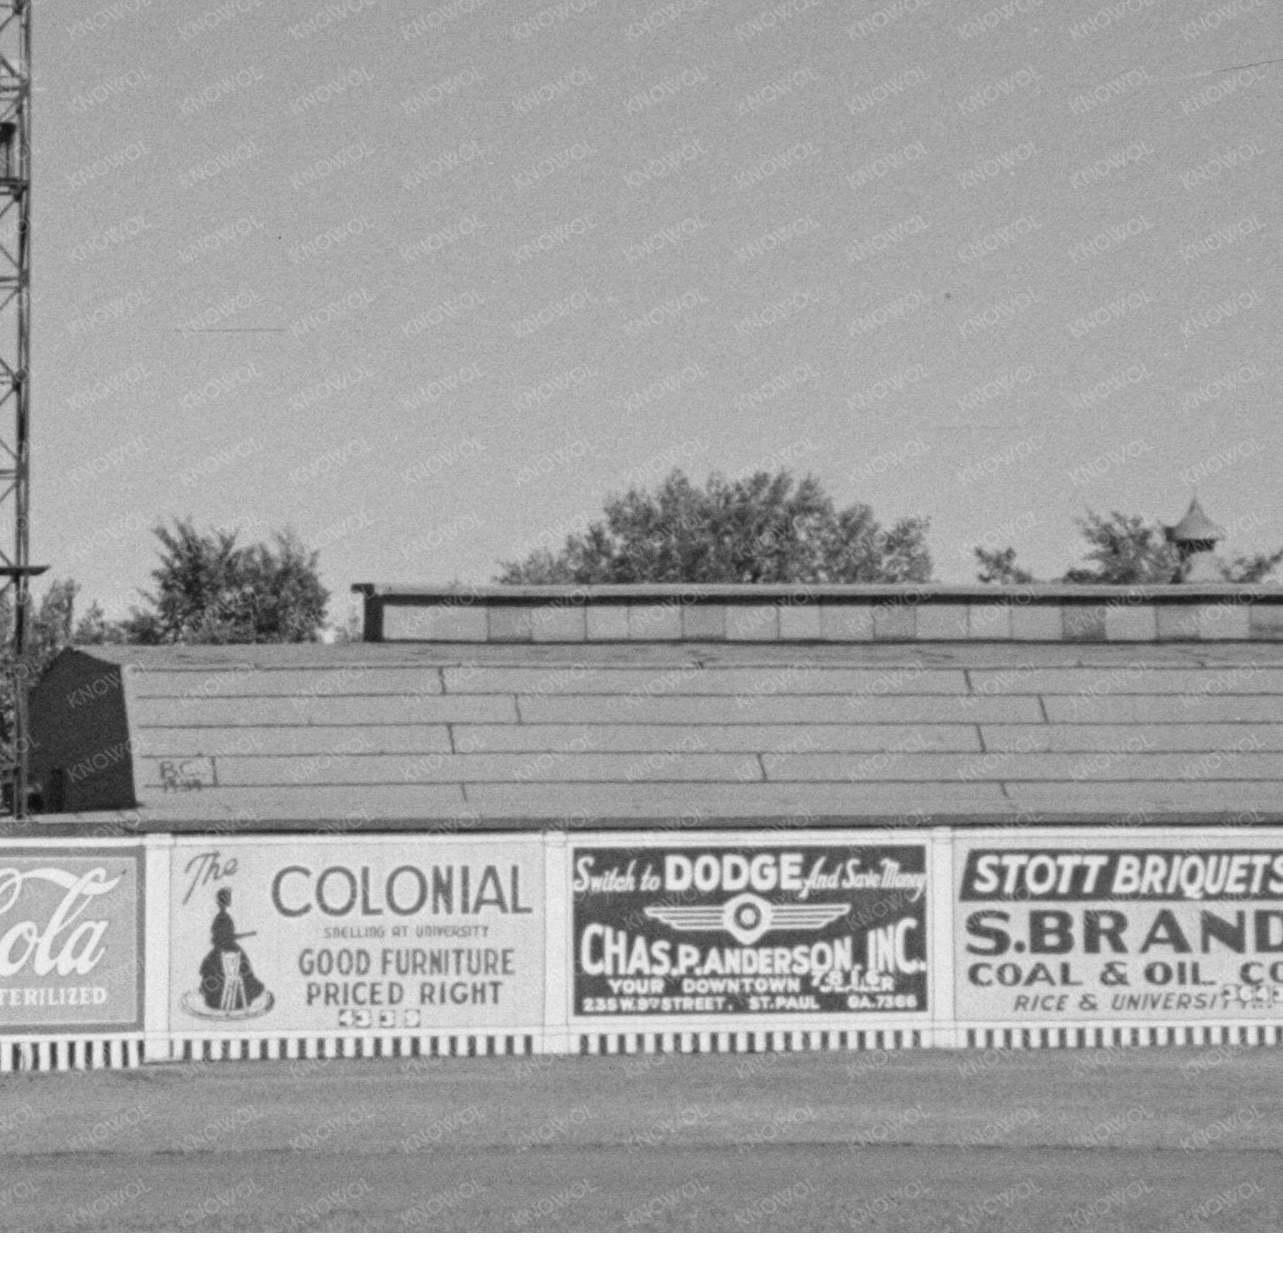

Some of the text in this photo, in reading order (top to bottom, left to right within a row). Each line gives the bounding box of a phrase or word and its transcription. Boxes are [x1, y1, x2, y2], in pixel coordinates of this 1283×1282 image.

[182, 850, 238, 905] The
[271, 865, 532, 917] COLONIAL
[573, 854, 928, 902] Switch to DODGE And Save Money
[973, 855, 1108, 894] STOTT
[298, 948, 515, 976] GOOD FURNITURE
[867, 918, 926, 974] INC.
[608, 978, 665, 994] YOUR
[682, 978, 801, 993] DOWNTOWN
[968, 962, 1083, 986] COAL
[1100, 962, 1131, 986] &
[1144, 962, 1216, 986] OIL
[306, 981, 503, 1006] PRICED RIGHT
[1014, 995, 1069, 1011] RICE
[1079, 994, 1097, 1011] &
